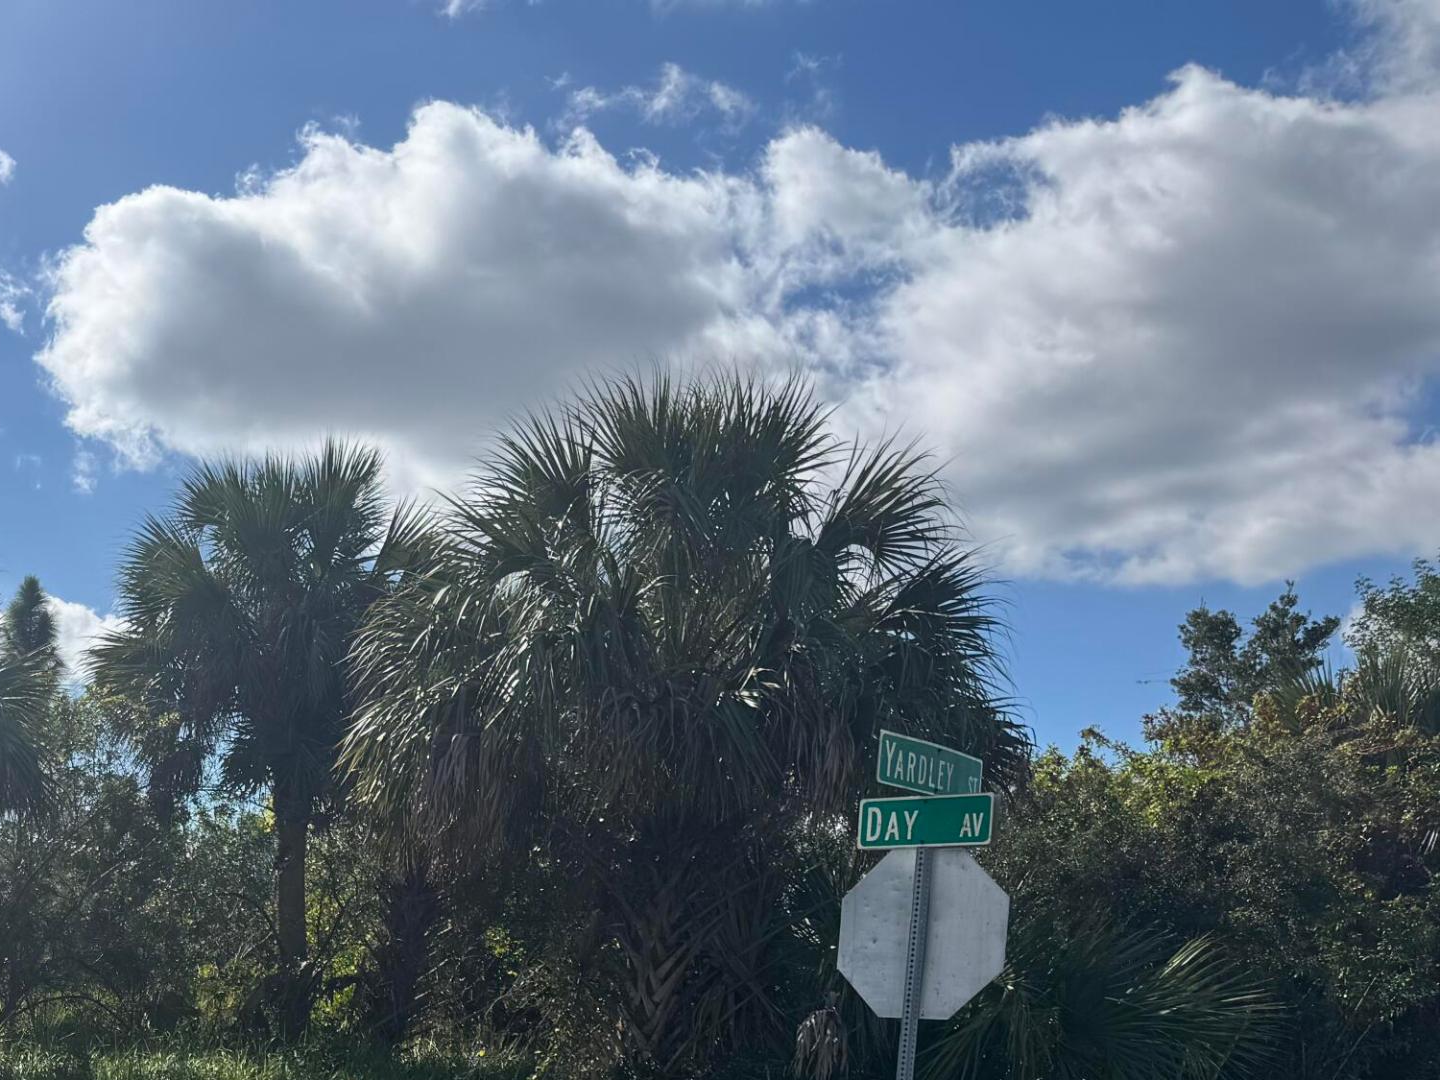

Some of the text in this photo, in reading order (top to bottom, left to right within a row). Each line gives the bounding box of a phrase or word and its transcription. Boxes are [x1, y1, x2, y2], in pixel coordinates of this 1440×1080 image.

[885, 739, 955, 791] YARDLEY
[865, 806, 984, 842] DAY AV
